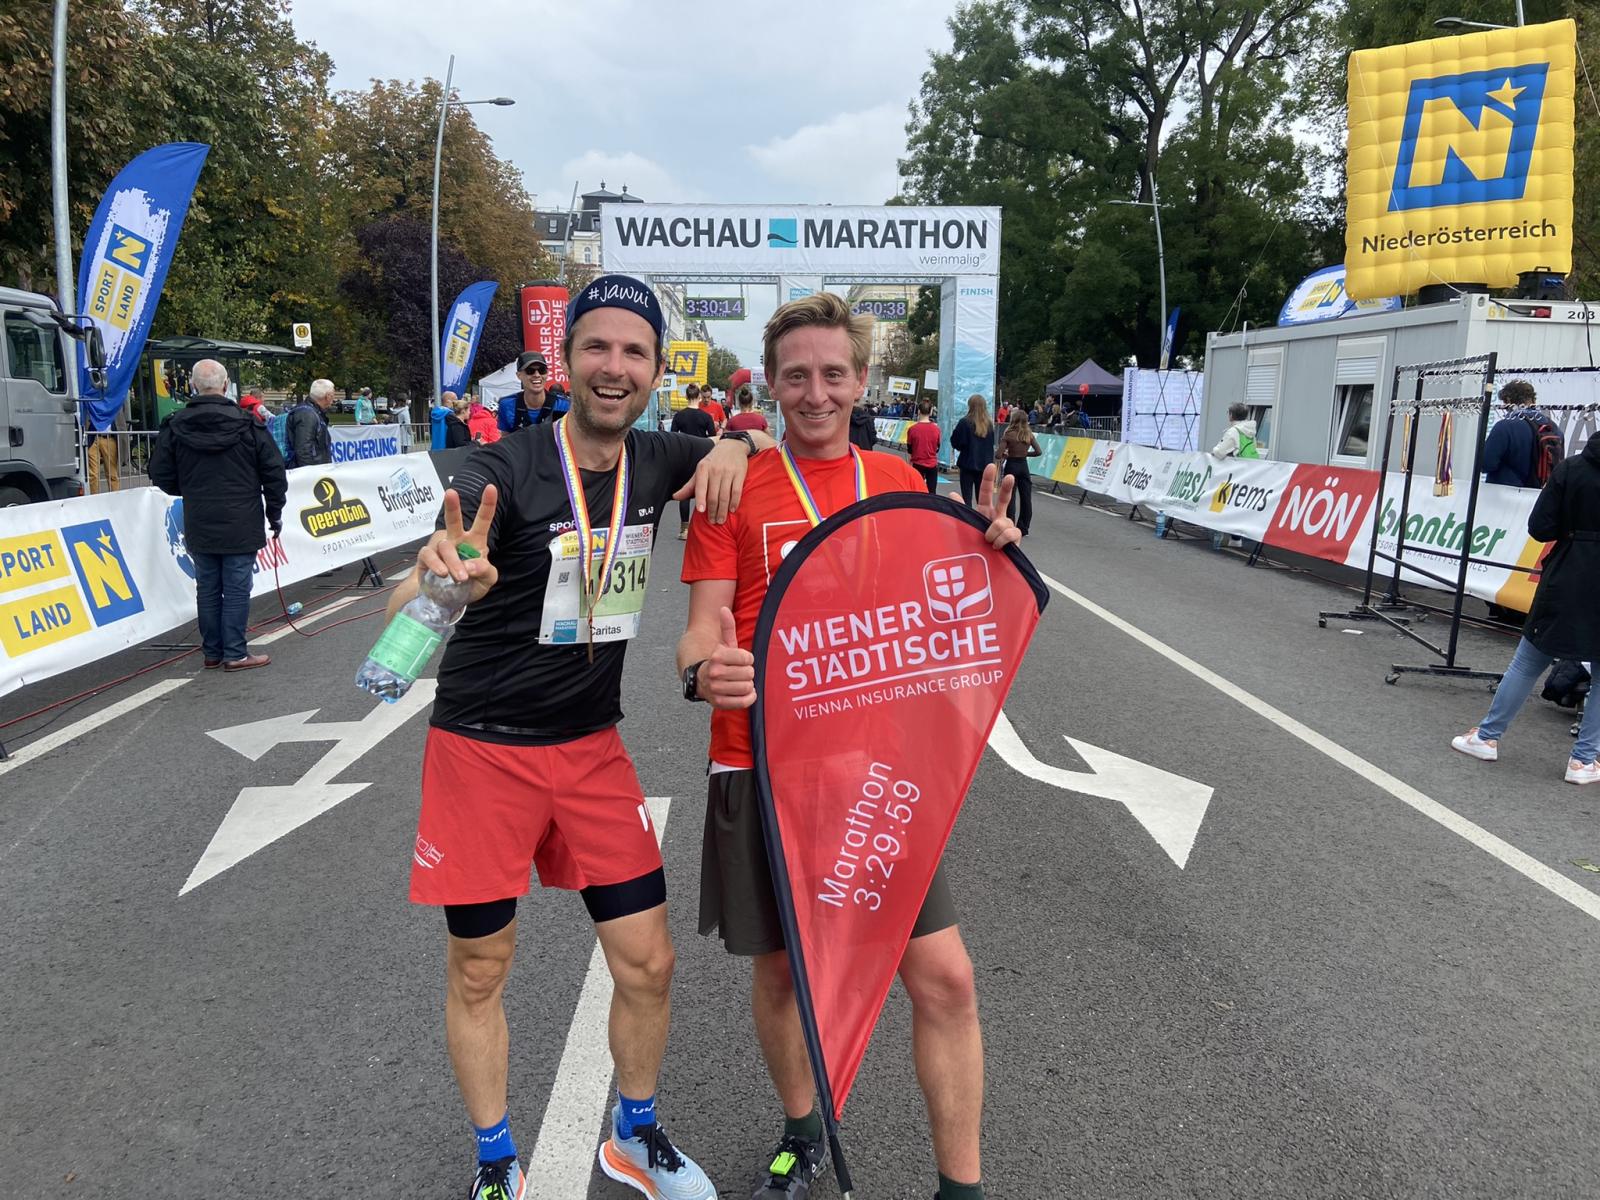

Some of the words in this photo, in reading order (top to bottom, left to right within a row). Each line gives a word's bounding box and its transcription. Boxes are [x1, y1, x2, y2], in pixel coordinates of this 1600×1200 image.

[615, 216, 761, 249] WACHAU
[803, 218, 987, 249] MARATHON
[1362, 219, 1556, 253] Niederösterreich
[95, 270, 114, 313] SPORT
[117, 285, 134, 319] LAND
[686, 299, 743, 313] 3:30:14
[960, 288, 993, 296] FINISH
[1567, 310, 1595, 320] 203
[330, 437, 398, 463] RSICHERUNG
[1123, 462, 1152, 491] Caritas
[1217, 473, 1274, 512] krems
[1278, 476, 1362, 542] NÖN
[322, 531, 376, 555] SPORTNAHRUNG
[563, 533, 578, 541] SPO
[1378, 497, 1507, 557] brantner
[13, 602, 72, 639] LAND
[590, 625, 622, 636] Caritas
[777, 600, 925, 656] WIENER
[786, 622, 1000, 690] STÄDTISCHE
[793, 697, 854, 720] VIENNA
[856, 677, 947, 706] INSURANCE
[949, 669, 1004, 690] GROUP
[817, 760, 893, 909] Marathon
[853, 779, 920, 912] 3:29:59
